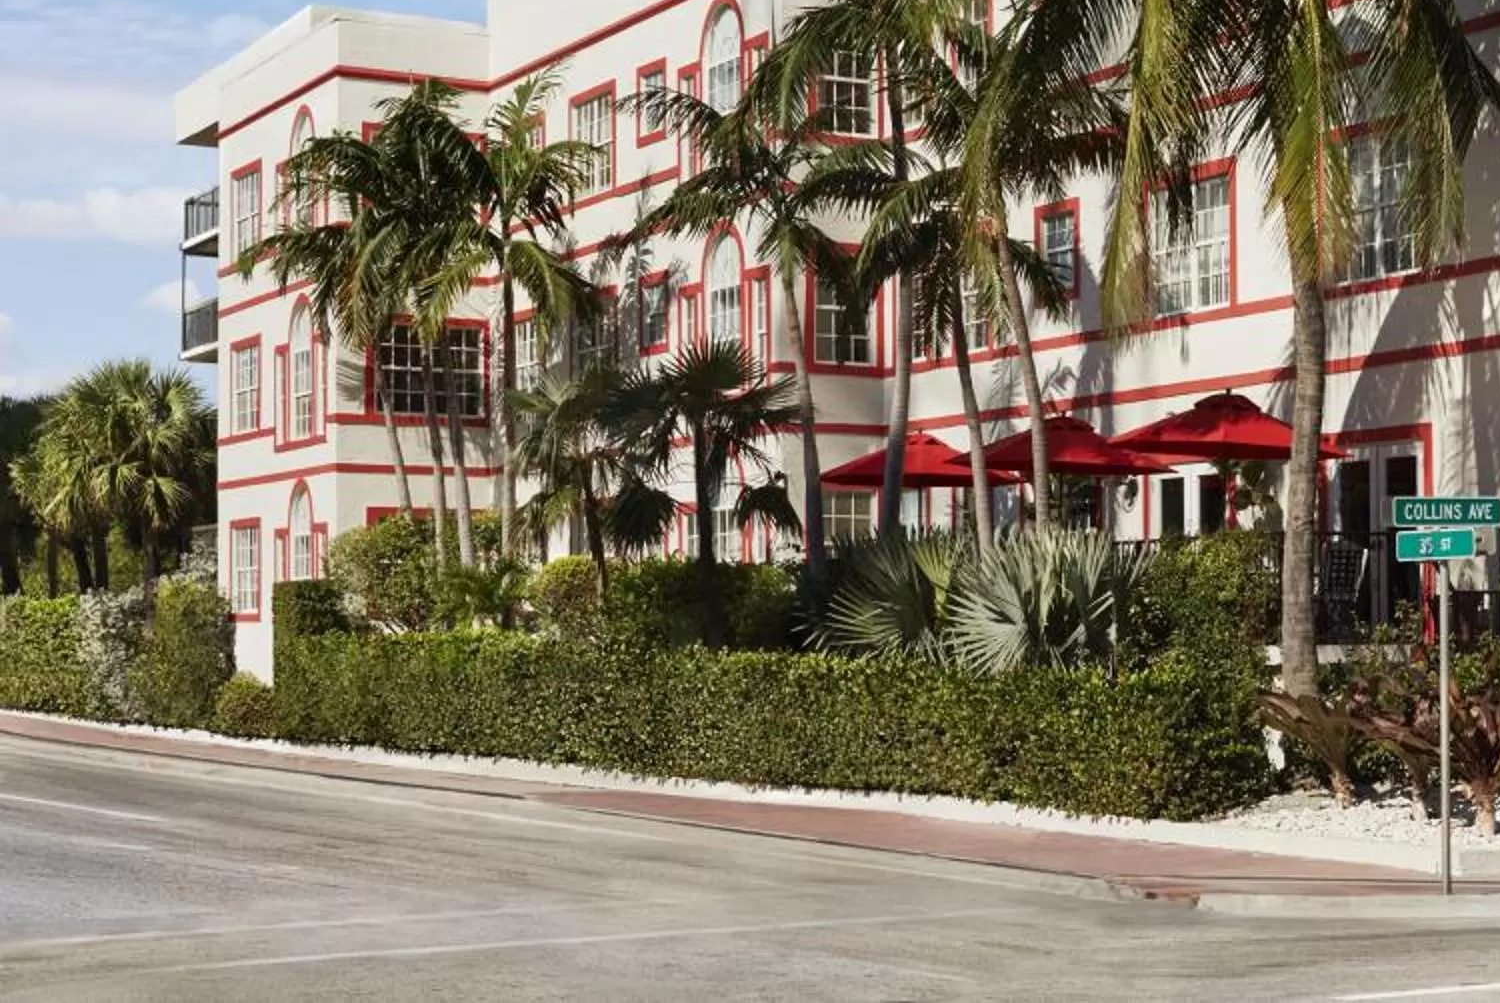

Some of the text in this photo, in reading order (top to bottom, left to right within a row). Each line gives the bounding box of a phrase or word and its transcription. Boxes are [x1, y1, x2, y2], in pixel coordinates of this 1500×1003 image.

[1404, 502, 1493, 520] COLLINS AVE
[1440, 537, 1452, 551] ST
